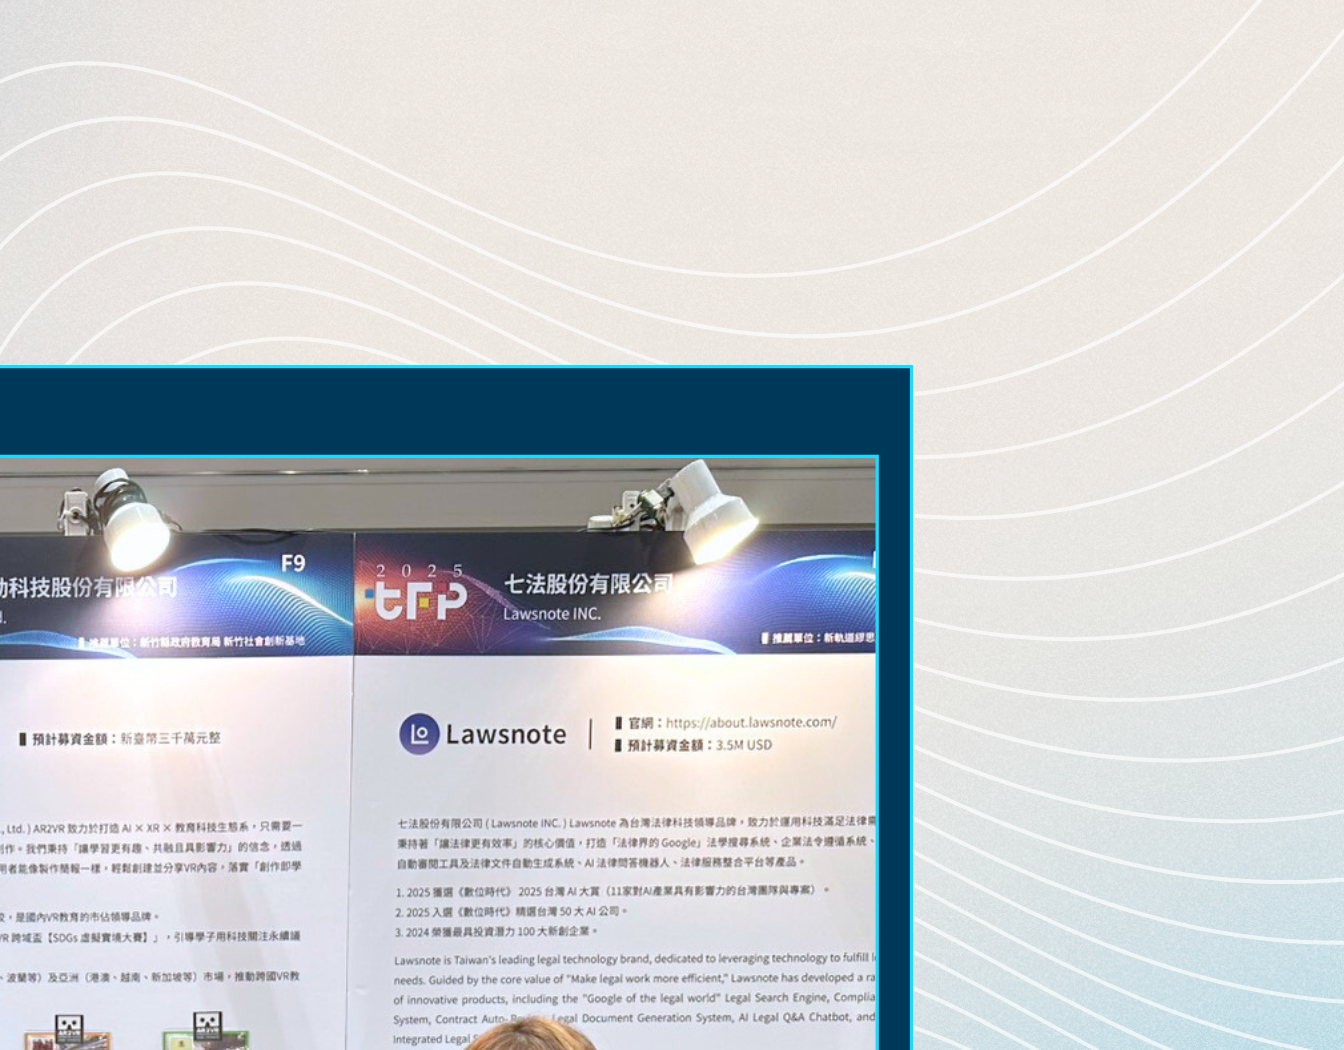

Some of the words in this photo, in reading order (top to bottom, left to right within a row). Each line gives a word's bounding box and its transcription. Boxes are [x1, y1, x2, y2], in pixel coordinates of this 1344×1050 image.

[281, 554, 306, 572] F9
[376, 563, 463, 578] 2025
[504, 572, 674, 596] 七法股份有限公司
[503, 607, 570, 621] Lawsnote
[573, 607, 601, 621] INC.
[446, 723, 567, 745] Lawsnote
[747, 739, 773, 751] USD
[397, 817, 483, 830] 七法股份有限公司
[491, 818, 538, 829] Lawsnote
[541, 818, 561, 829] INC.
[569, 818, 616, 829] Lawsnote
[406, 927, 430, 938] 2024
[518, 927, 536, 937] 100
[394, 956, 442, 966] Lawsnote
[454, 955, 496, 966] Taiwan's
[498, 955, 535, 968] leading
[537, 955, 561, 967] legal
[563, 954, 617, 967] technology
[620, 953, 652, 966] brand,
[654, 953, 704, 965] dedicated
[718, 953, 770, 966] leveraging
[772, 952, 828, 966] technology
[843, 951, 869, 963] fulfill
[393, 975, 426, 986] needs.
[428, 974, 464, 985] Guided
[500, 976, 522, 985] core
[524, 974, 551, 985] value
[599, 974, 623, 986] legal
[625, 973, 651, 984] work
[653, 975, 679, 984] more
[731, 972, 779, 984] Lawsnote
[801, 971, 854, 985] developed
[407, 994, 459, 1006] innovative
[461, 994, 509, 1007] products,
[512, 993, 558, 1006] including
[754, 992, 789, 1004] Search
[435, 1014, 478, 1025] Contract
[809, 1012, 853, 1025] Chatbot,
